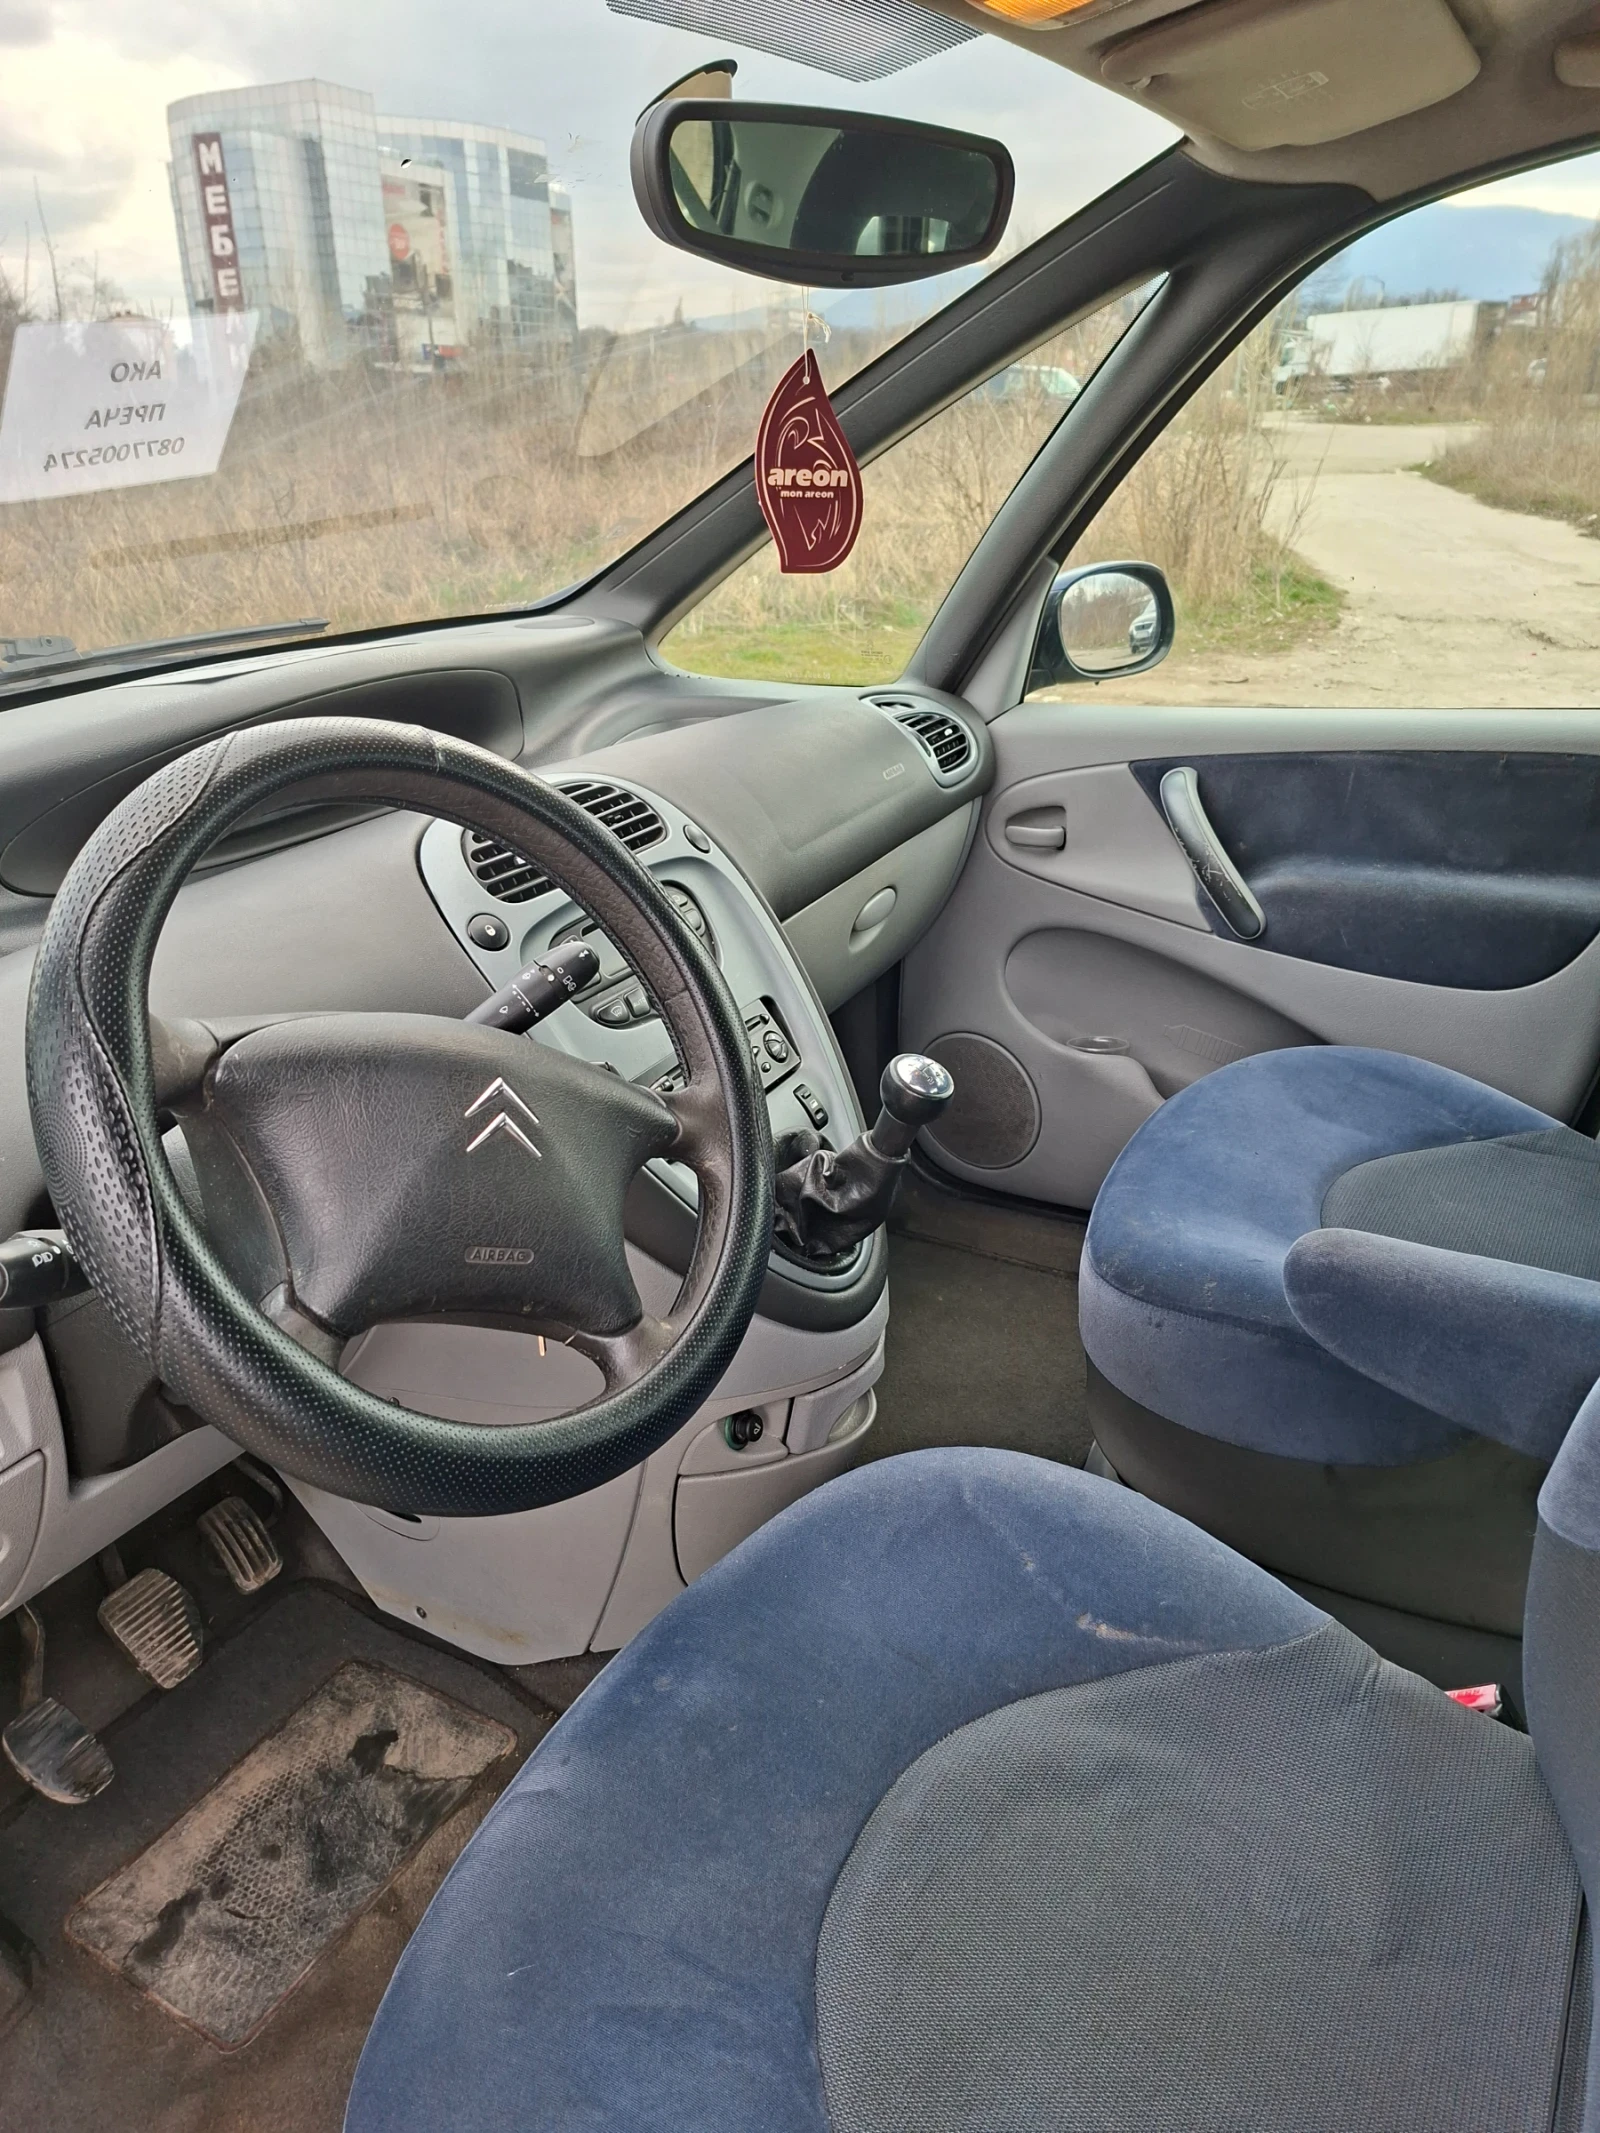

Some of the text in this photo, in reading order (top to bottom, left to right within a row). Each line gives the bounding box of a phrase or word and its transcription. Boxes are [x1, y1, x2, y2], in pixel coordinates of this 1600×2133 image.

[767, 467, 849, 488] areon
[780, 489, 834, 499] mon areon
[470, 1247, 527, 1262] AIRBAG
